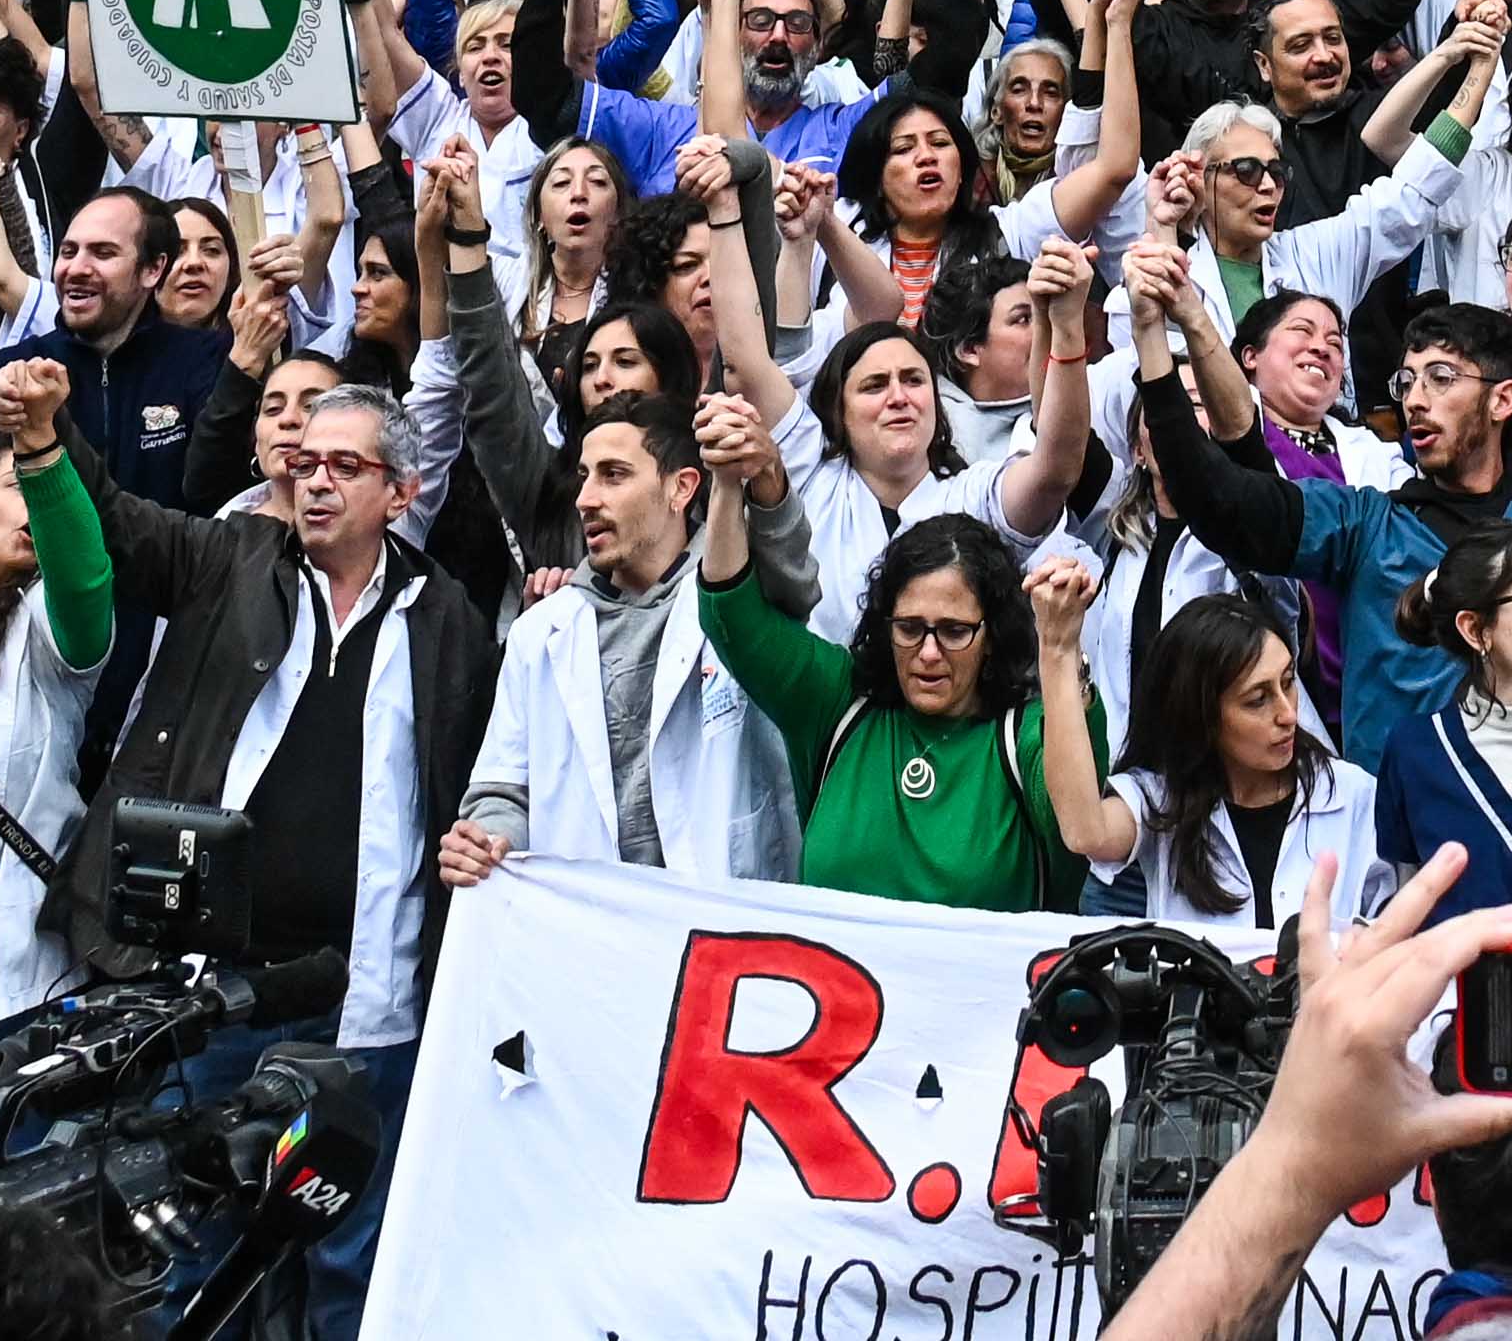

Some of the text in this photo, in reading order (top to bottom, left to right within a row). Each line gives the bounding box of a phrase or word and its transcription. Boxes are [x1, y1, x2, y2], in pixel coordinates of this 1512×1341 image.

[177, 78, 189, 101] Y
[273, 64, 293, 97] DE
[198, 86, 265, 110] SALUD
[166, 887, 179, 907] 8
[296, 1176, 352, 1216] A24
